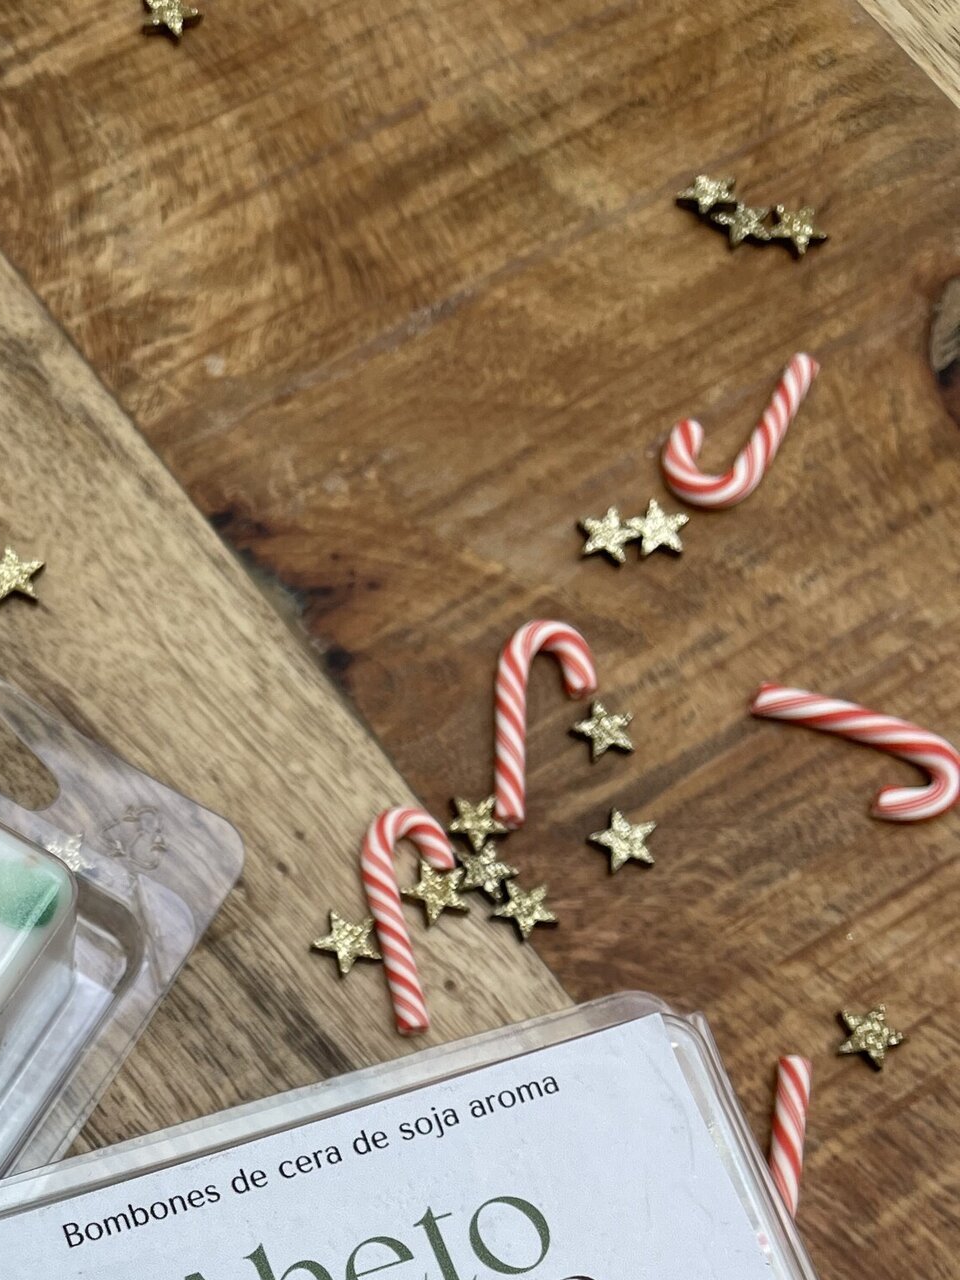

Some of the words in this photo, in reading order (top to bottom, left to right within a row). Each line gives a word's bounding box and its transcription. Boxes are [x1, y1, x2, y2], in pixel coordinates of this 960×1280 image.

[62, 1184, 221, 1249] Bombones
[231, 1168, 269, 1195] de
[279, 1145, 343, 1180] cera
[353, 1129, 390, 1156] de
[399, 1106, 460, 1141] soja
[468, 1076, 560, 1119] aroma
